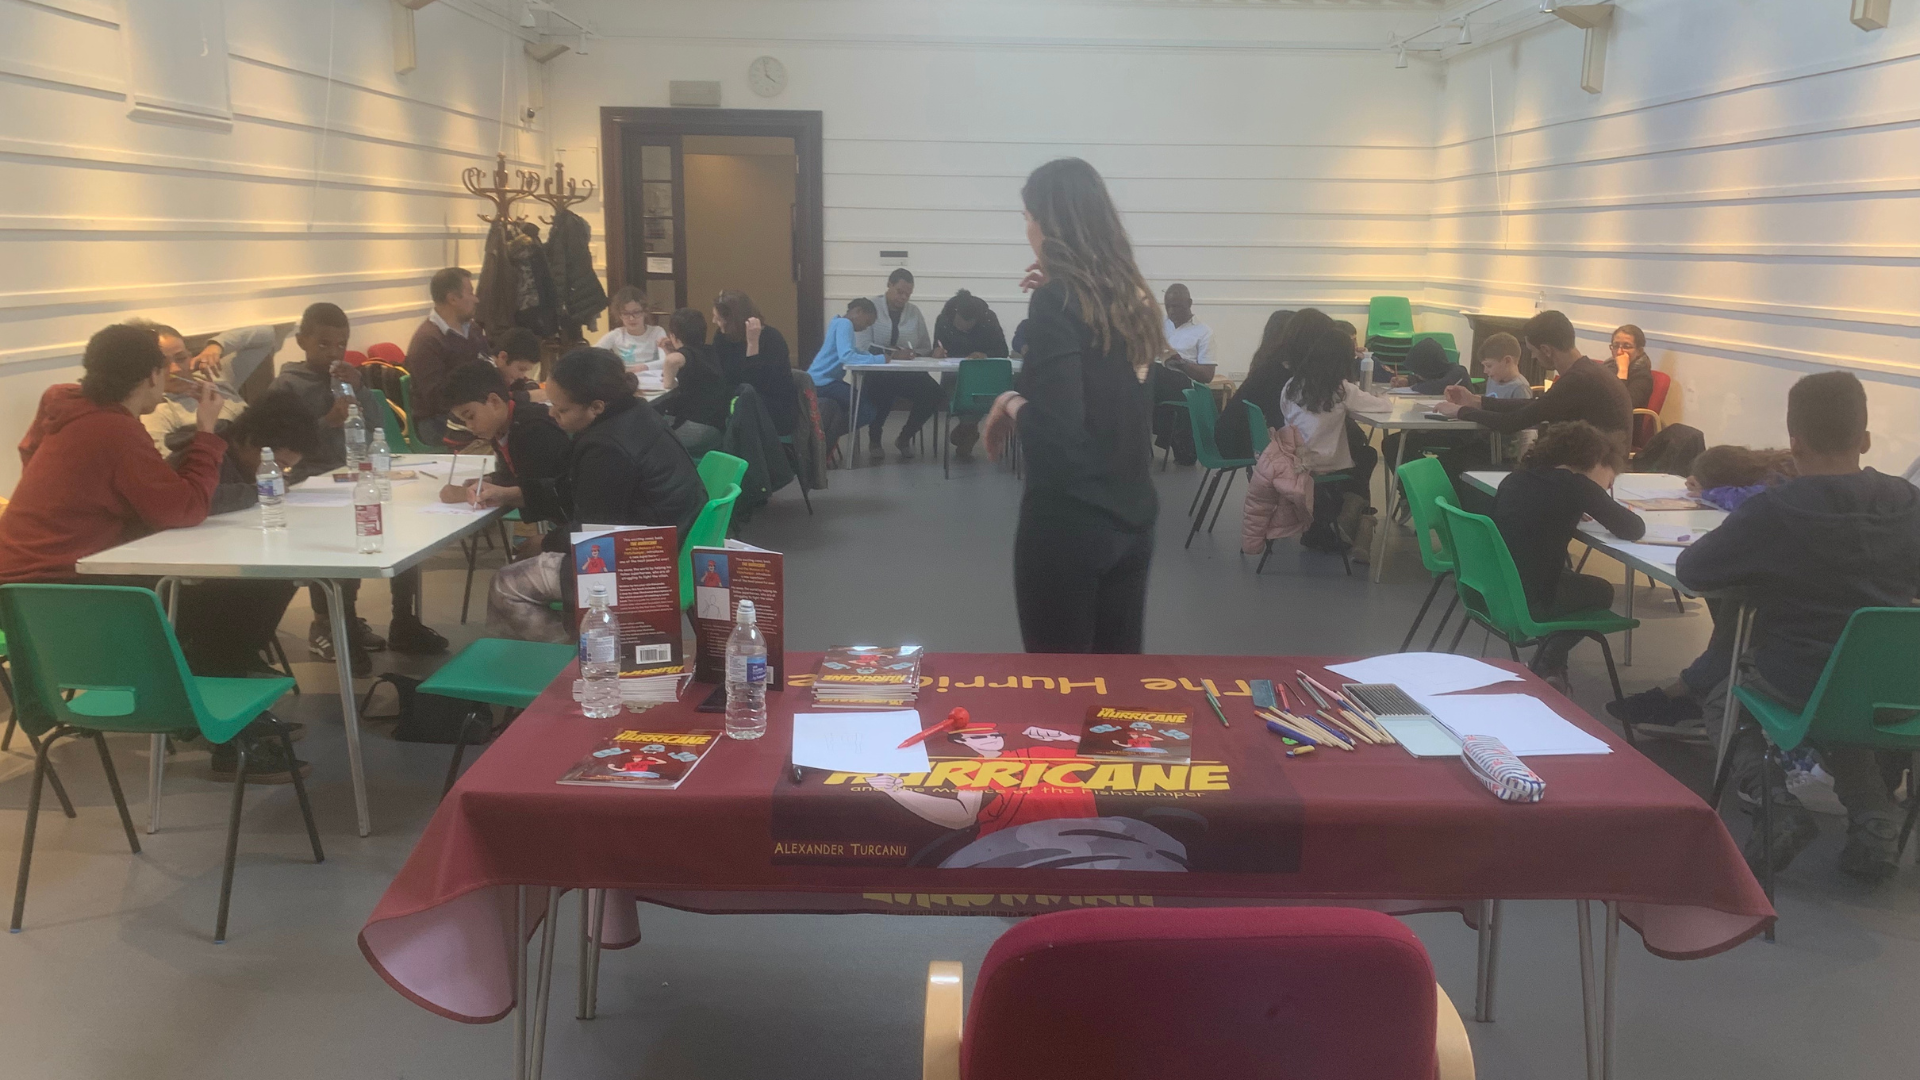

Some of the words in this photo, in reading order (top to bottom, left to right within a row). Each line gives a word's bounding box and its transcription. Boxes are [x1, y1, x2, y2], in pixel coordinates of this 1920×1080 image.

[1097, 710, 1188, 723] HURRICANE
[613, 731, 712, 745] HURRICANE
[1041, 786, 1074, 794] the
[774, 842, 844, 856] ALEXANDER
[850, 843, 907, 856] TURCANU
